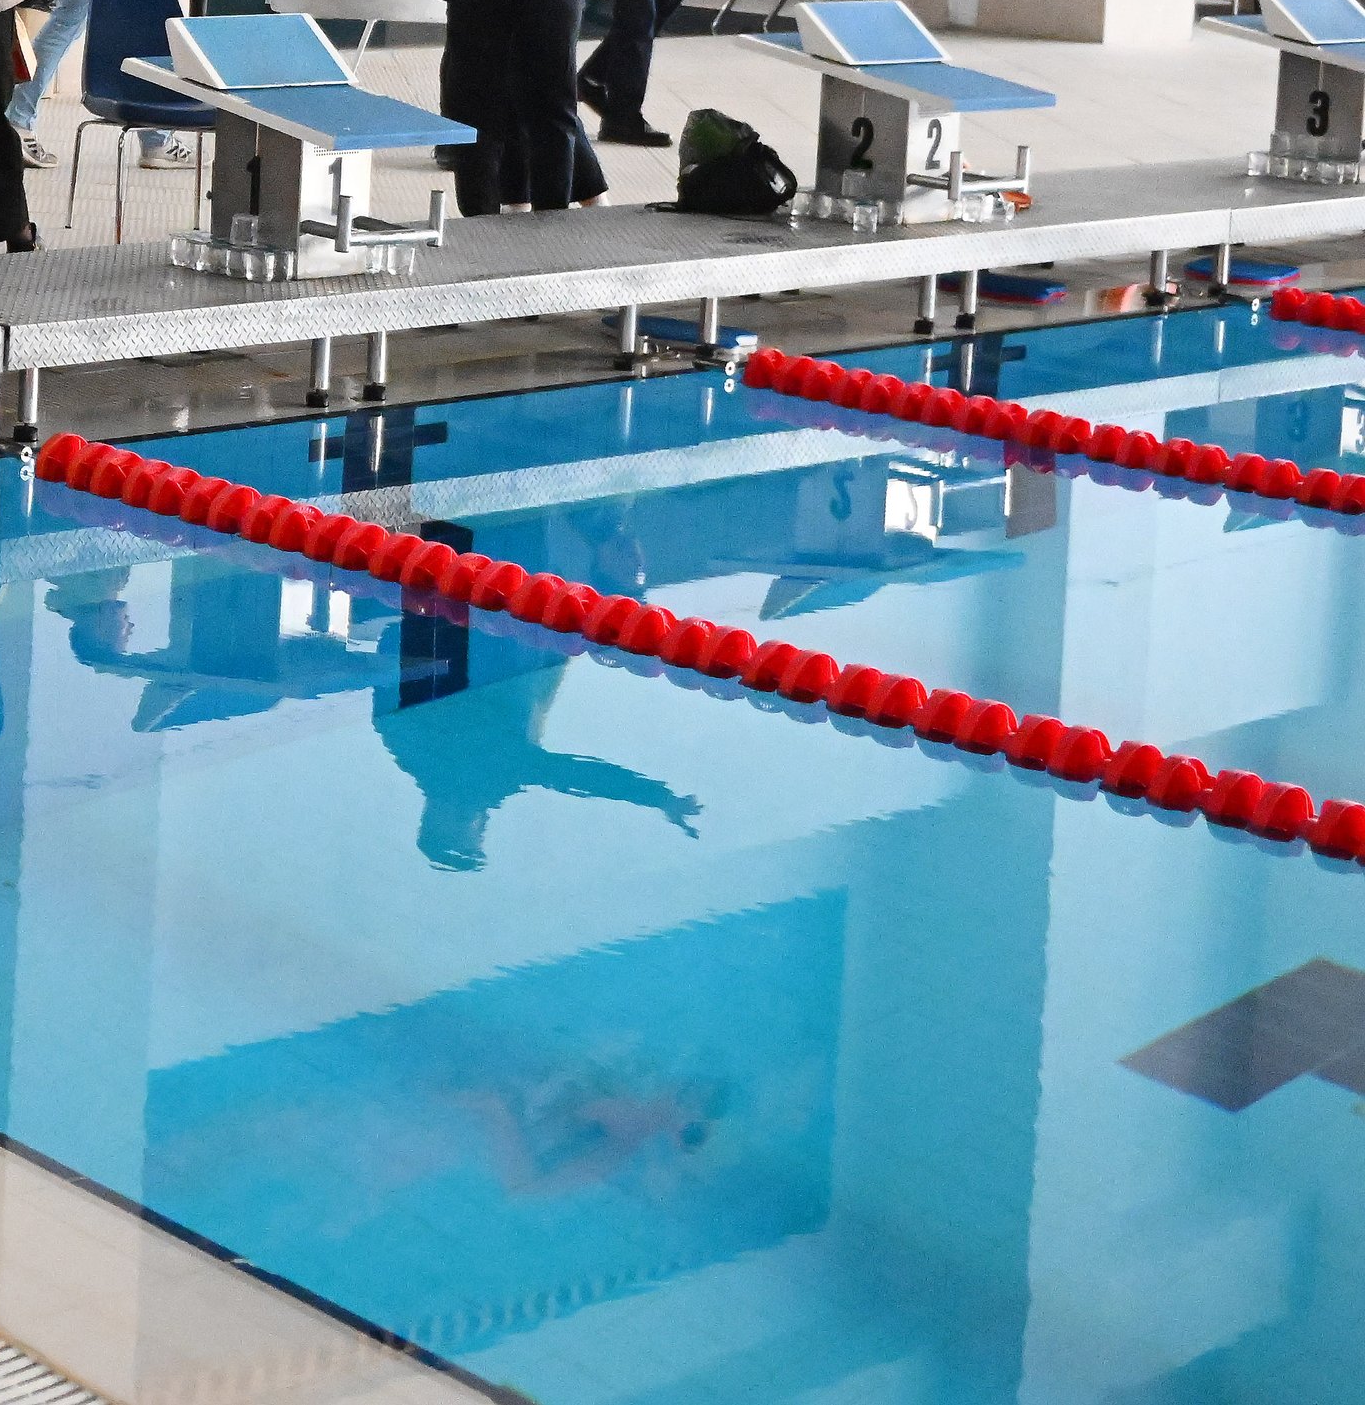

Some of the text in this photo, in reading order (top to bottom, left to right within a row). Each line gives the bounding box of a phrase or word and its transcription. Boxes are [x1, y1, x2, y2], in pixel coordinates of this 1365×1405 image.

[1306, 90, 1330, 137] 3
[851, 116, 874, 170] 2
[925, 119, 942, 170] 2
[328, 156, 343, 216] 1
